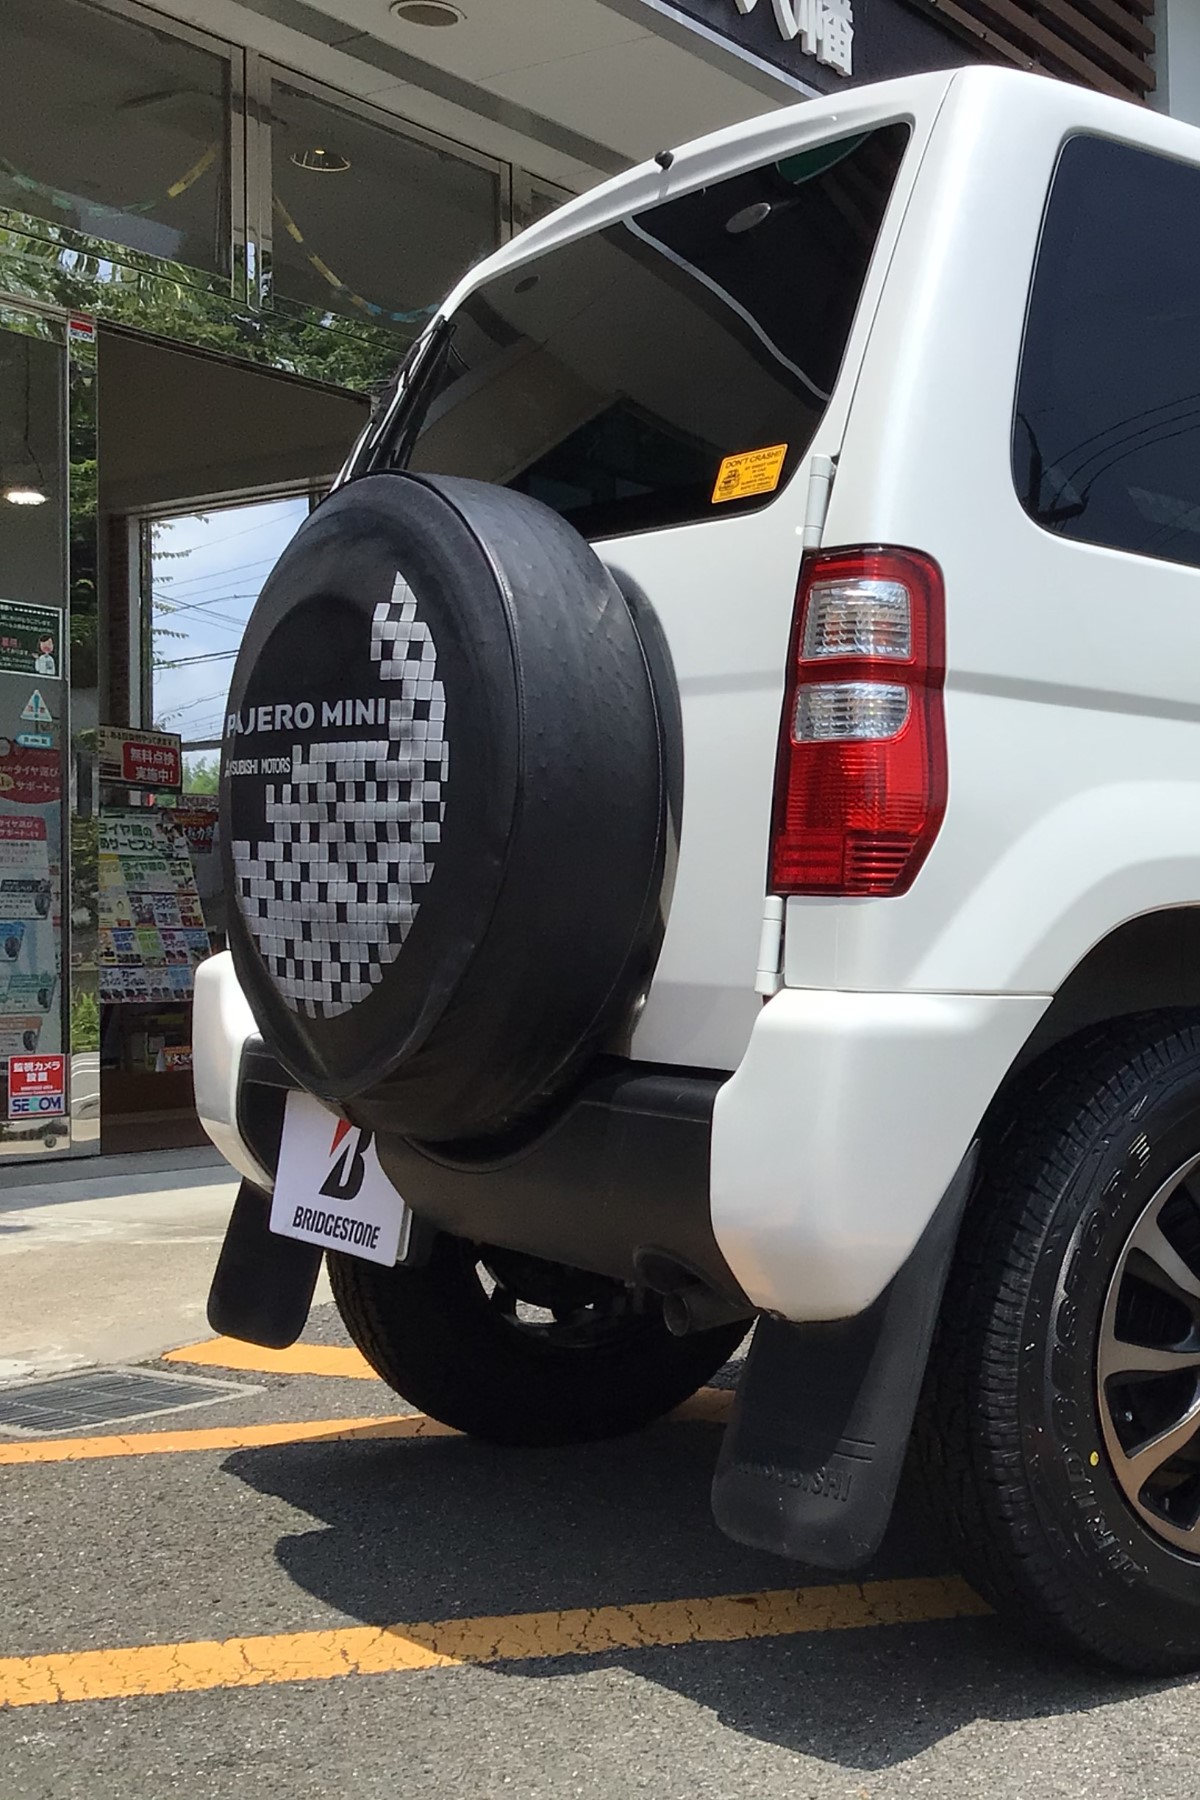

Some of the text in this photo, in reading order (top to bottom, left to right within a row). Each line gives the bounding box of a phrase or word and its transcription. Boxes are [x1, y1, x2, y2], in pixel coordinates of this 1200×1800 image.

[226, 698, 386, 738] PAJERO MINI
[130, 747, 175, 767] 無料点検
[261, 757, 291, 774] MOTORS
[12, 1096, 62, 1112] SECOM
[292, 1205, 381, 1250] BRIDGESTONE
